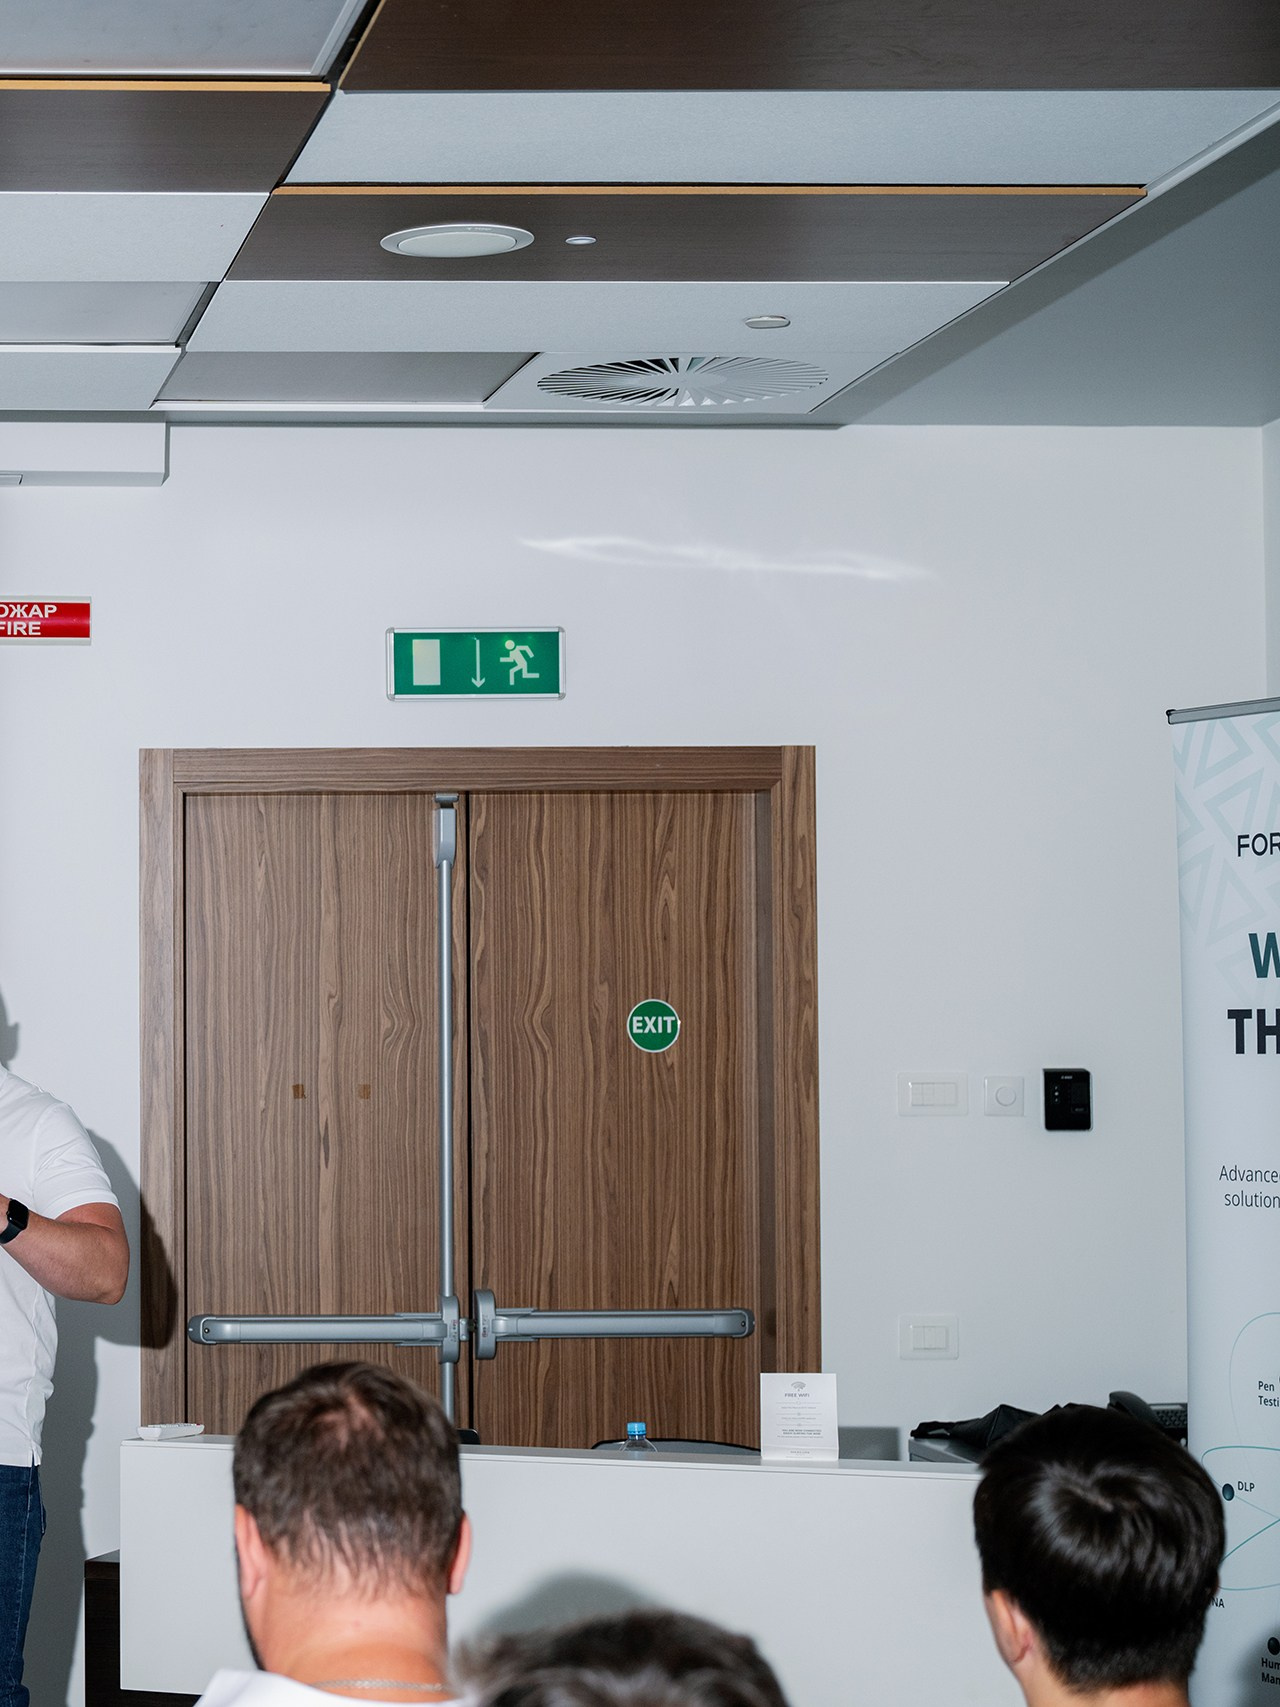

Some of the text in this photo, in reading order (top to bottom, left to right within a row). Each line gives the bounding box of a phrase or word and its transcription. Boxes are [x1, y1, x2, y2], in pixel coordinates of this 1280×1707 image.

[632, 1015, 676, 1034] EXIT
[1219, 1165, 1280, 1183] Advance
[1258, 1380, 1275, 1392] Pen
[1258, 1395, 1280, 1407] Testi
[1237, 1481, 1255, 1492] DLP
[1208, 1597, 1225, 1608] NA
